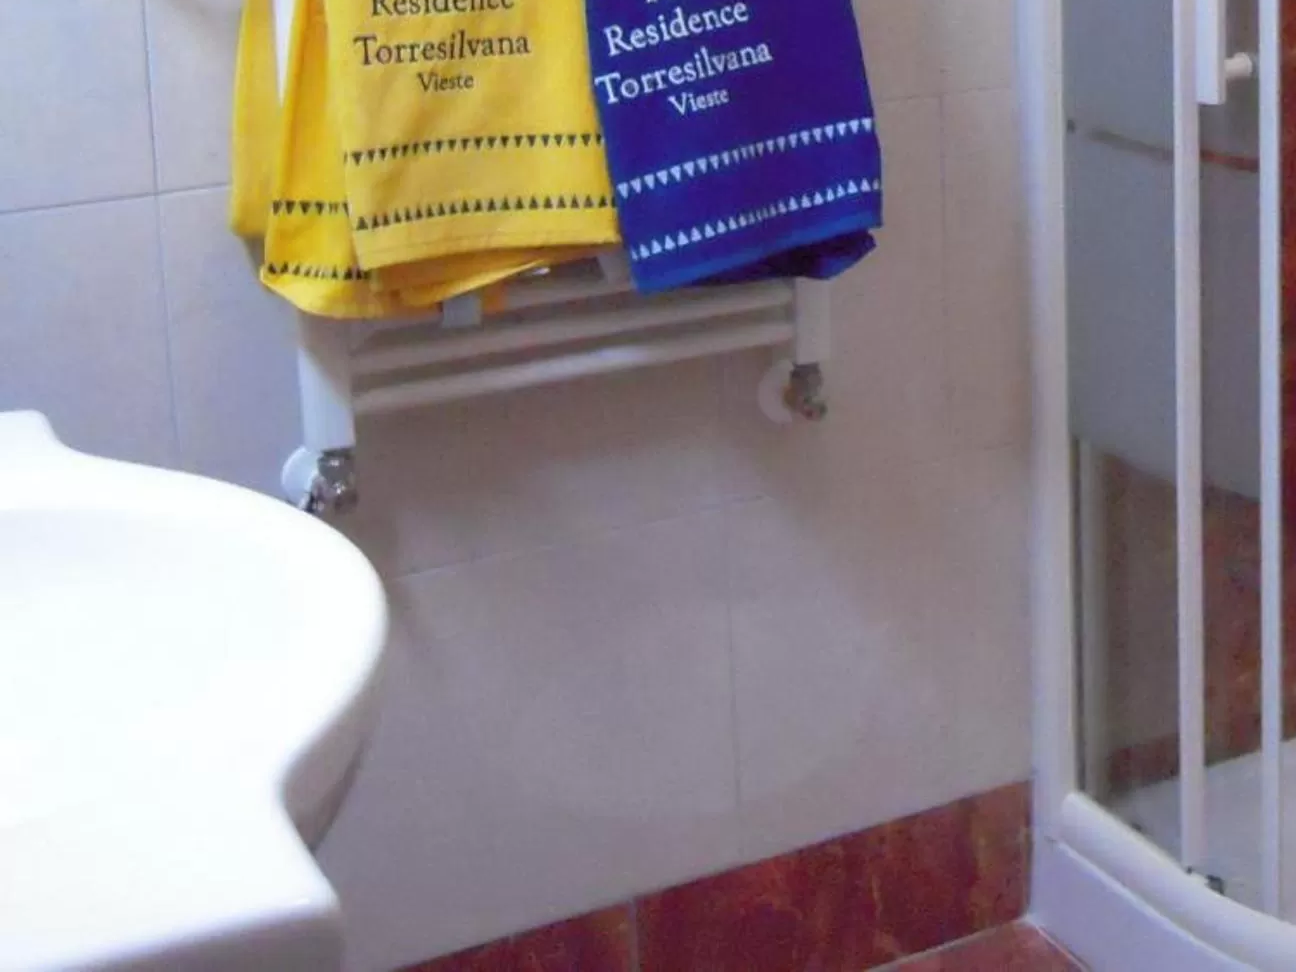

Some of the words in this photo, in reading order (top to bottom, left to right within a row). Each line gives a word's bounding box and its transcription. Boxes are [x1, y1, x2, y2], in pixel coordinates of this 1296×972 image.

[603, 1, 749, 56] Residence
[353, 30, 531, 66] Torresilvana
[417, 71, 474, 93] Vieste
[594, 42, 773, 105] Torresilvana
[668, 88, 730, 116] Vieste
